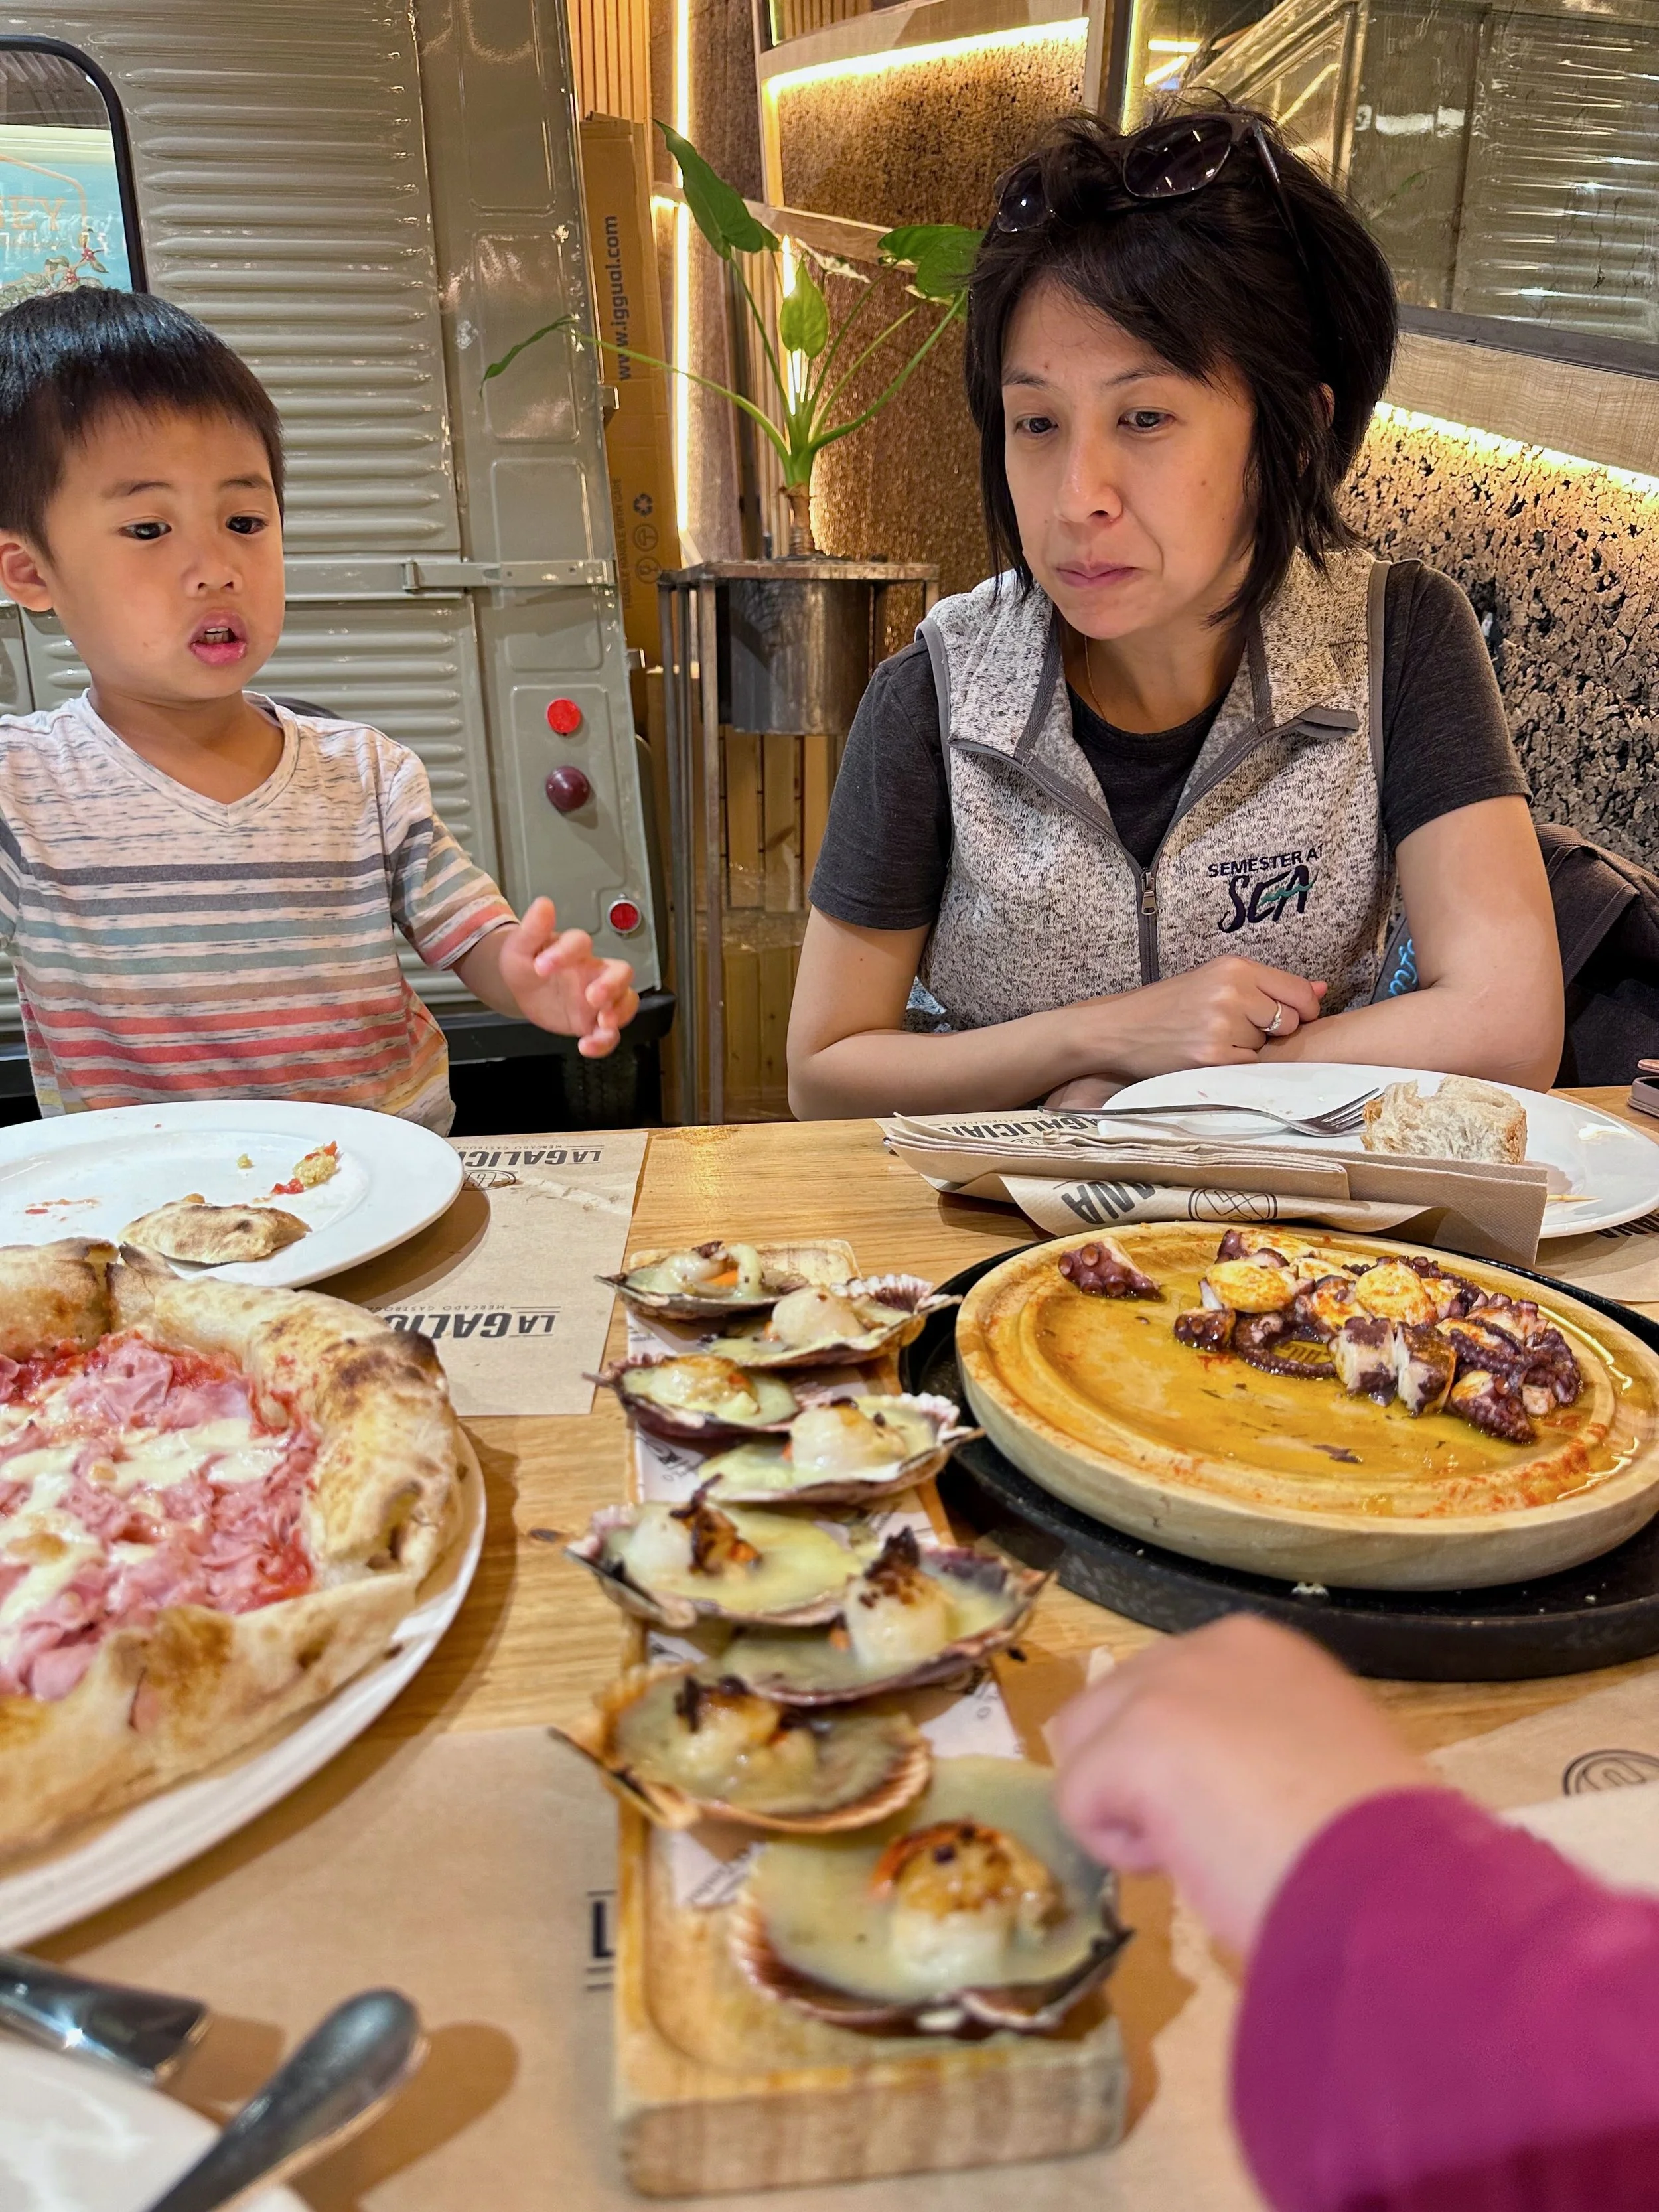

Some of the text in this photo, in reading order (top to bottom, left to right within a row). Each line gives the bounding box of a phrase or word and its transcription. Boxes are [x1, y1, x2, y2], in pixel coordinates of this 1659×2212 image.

[0, 195, 66, 231] EY
[1208, 850, 1302, 878] SEMESTER
[573, 1150, 602, 1163] LA
[519, 1315, 556, 1334] LA
